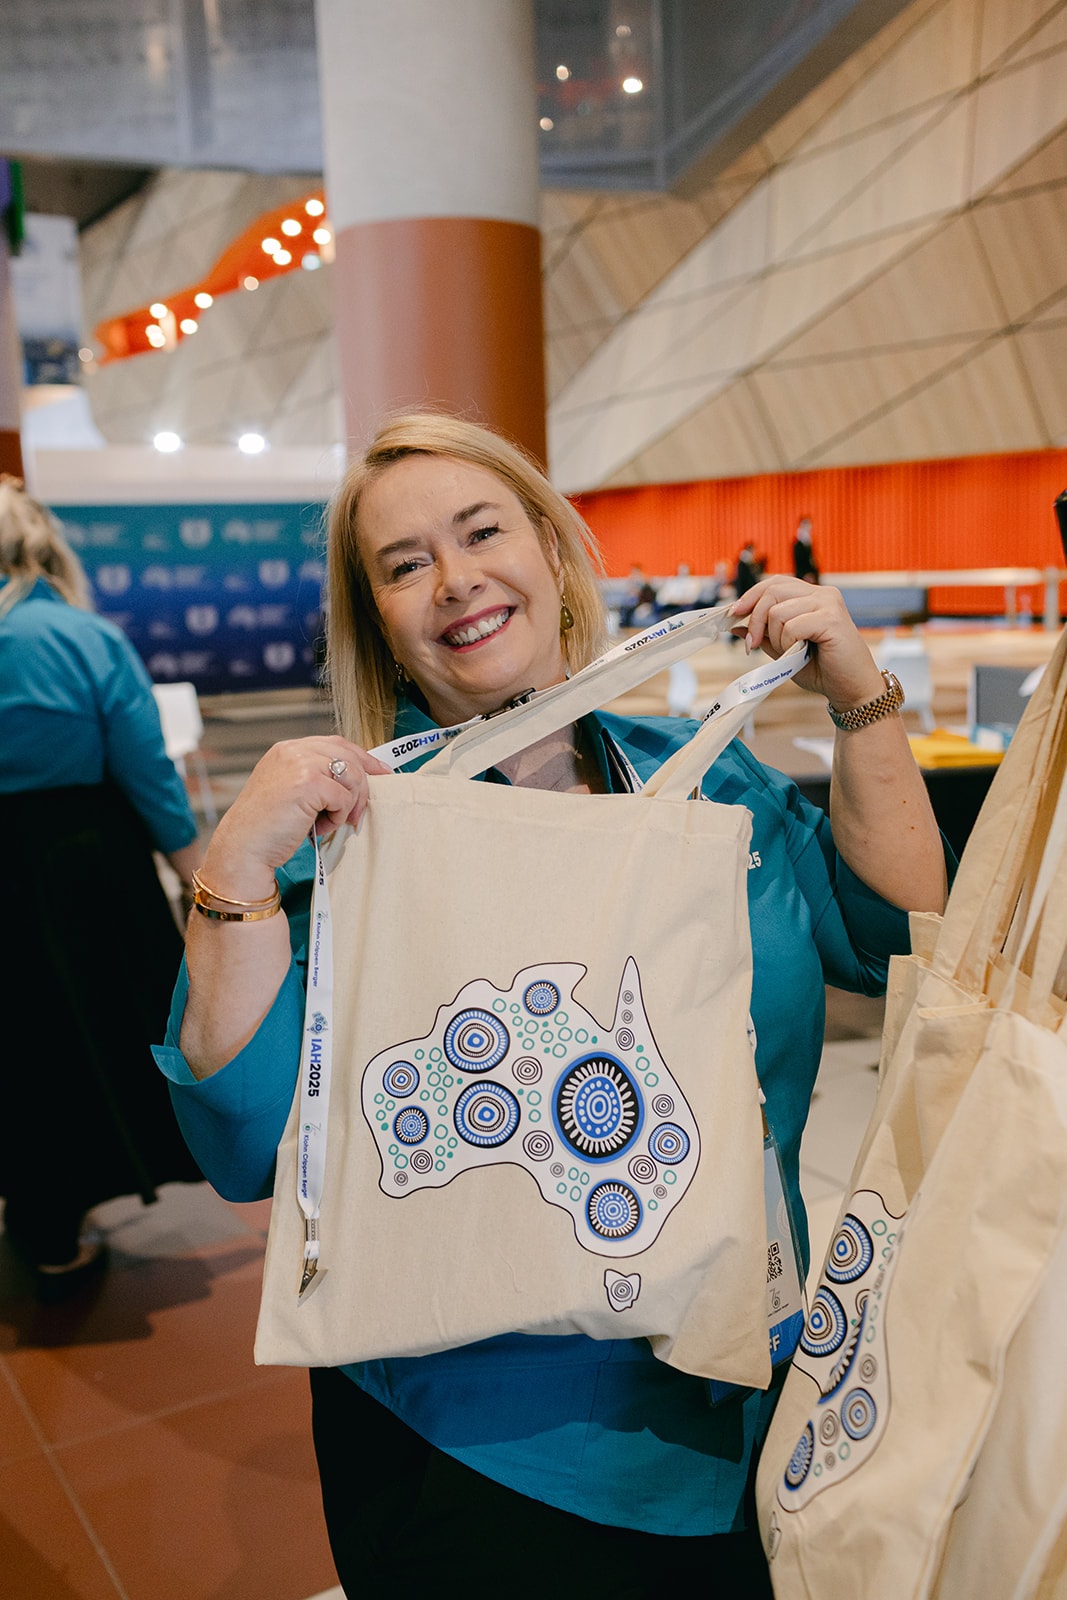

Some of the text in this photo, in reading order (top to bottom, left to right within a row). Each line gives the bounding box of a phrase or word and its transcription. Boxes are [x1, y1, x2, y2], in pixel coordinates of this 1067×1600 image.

[392, 733, 440, 758] IAH2025
[312, 966, 320, 988] Berger
[308, 1039, 322, 1097] IAH2025
[301, 1153, 309, 1178] Crippen
